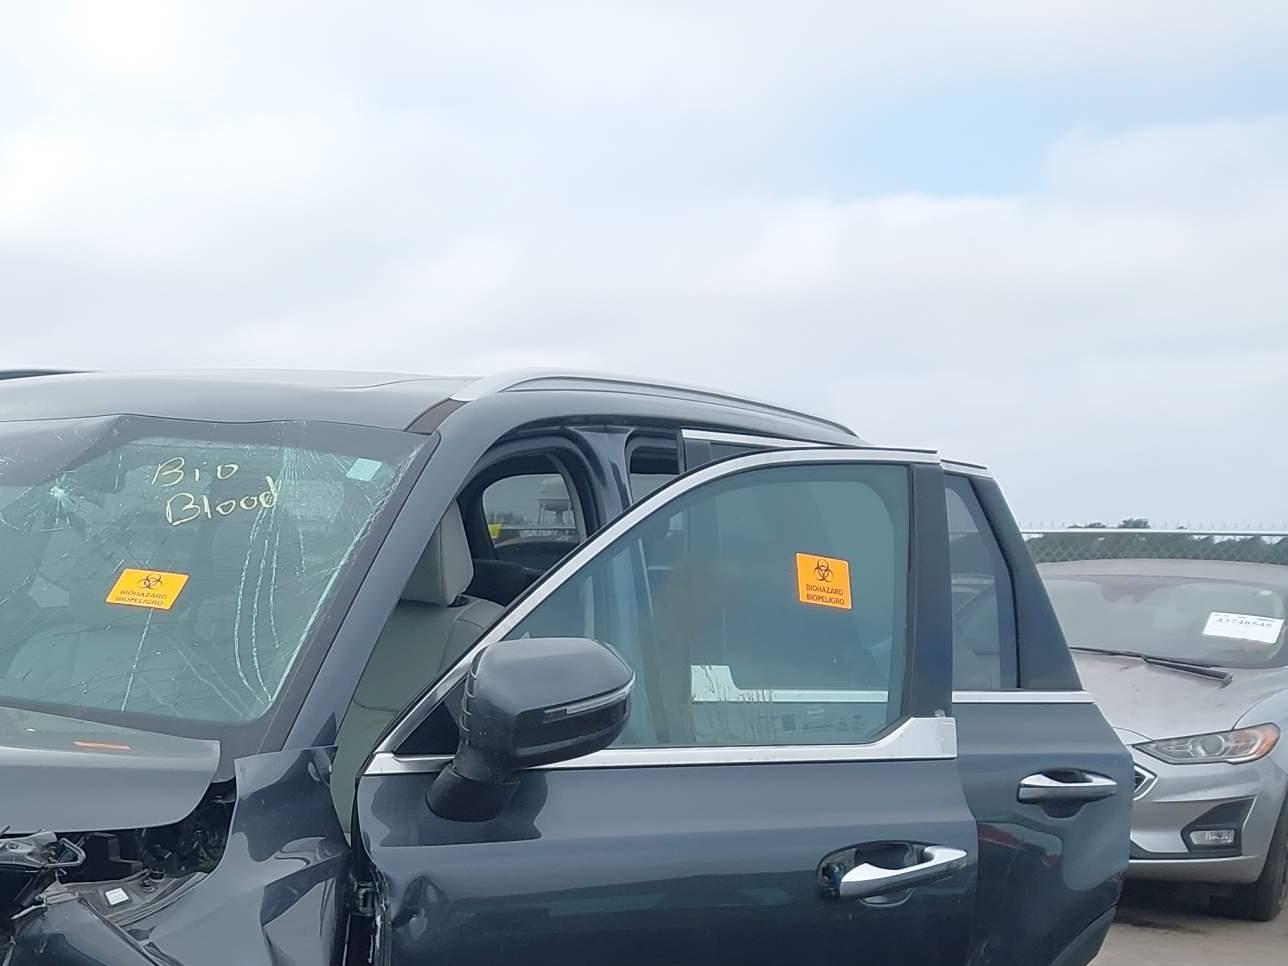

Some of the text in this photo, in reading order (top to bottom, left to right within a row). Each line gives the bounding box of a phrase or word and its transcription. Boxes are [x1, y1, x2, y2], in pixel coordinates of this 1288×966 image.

[165, 475, 277, 526] Blood
[119, 589, 168, 600] BIOHAZARD
[806, 584, 844, 595] BIOHAZARD
[115, 596, 164, 606] BIOPELIGRO
[806, 593, 845, 605] BIOPELIGRO
